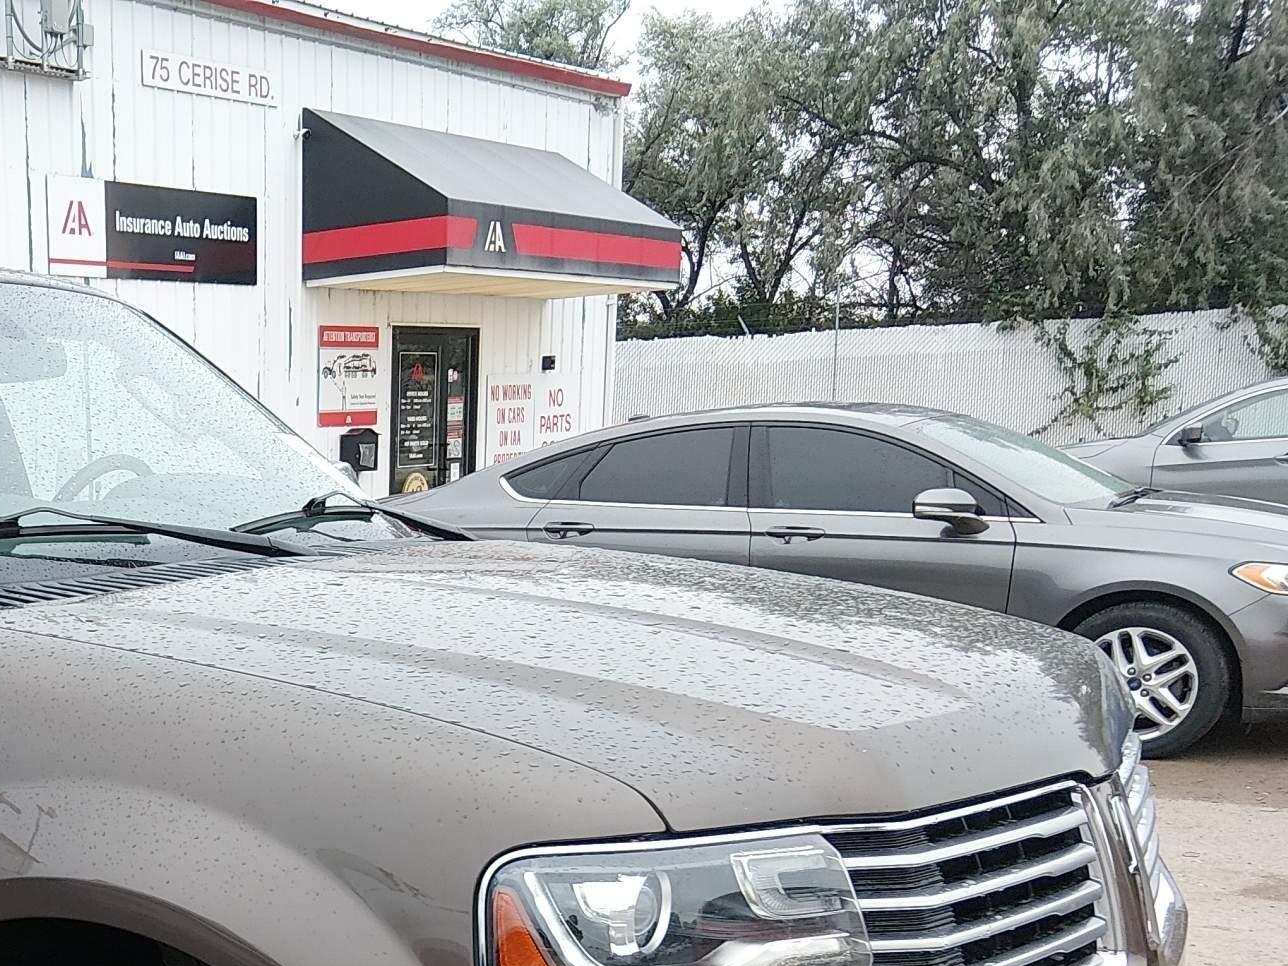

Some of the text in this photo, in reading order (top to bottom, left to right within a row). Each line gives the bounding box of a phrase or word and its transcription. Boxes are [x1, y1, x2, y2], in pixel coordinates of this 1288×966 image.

[149, 55, 274, 100] 75 CERISE RD.
[115, 210, 249, 243] Insurance Auto Auctions
[490, 384, 531, 402] NO WORKING
[549, 388, 564, 407] NO
[496, 407, 525, 425] ON CARS
[539, 413, 571, 433] PARTS
[499, 430, 521, 447] ON IAA
